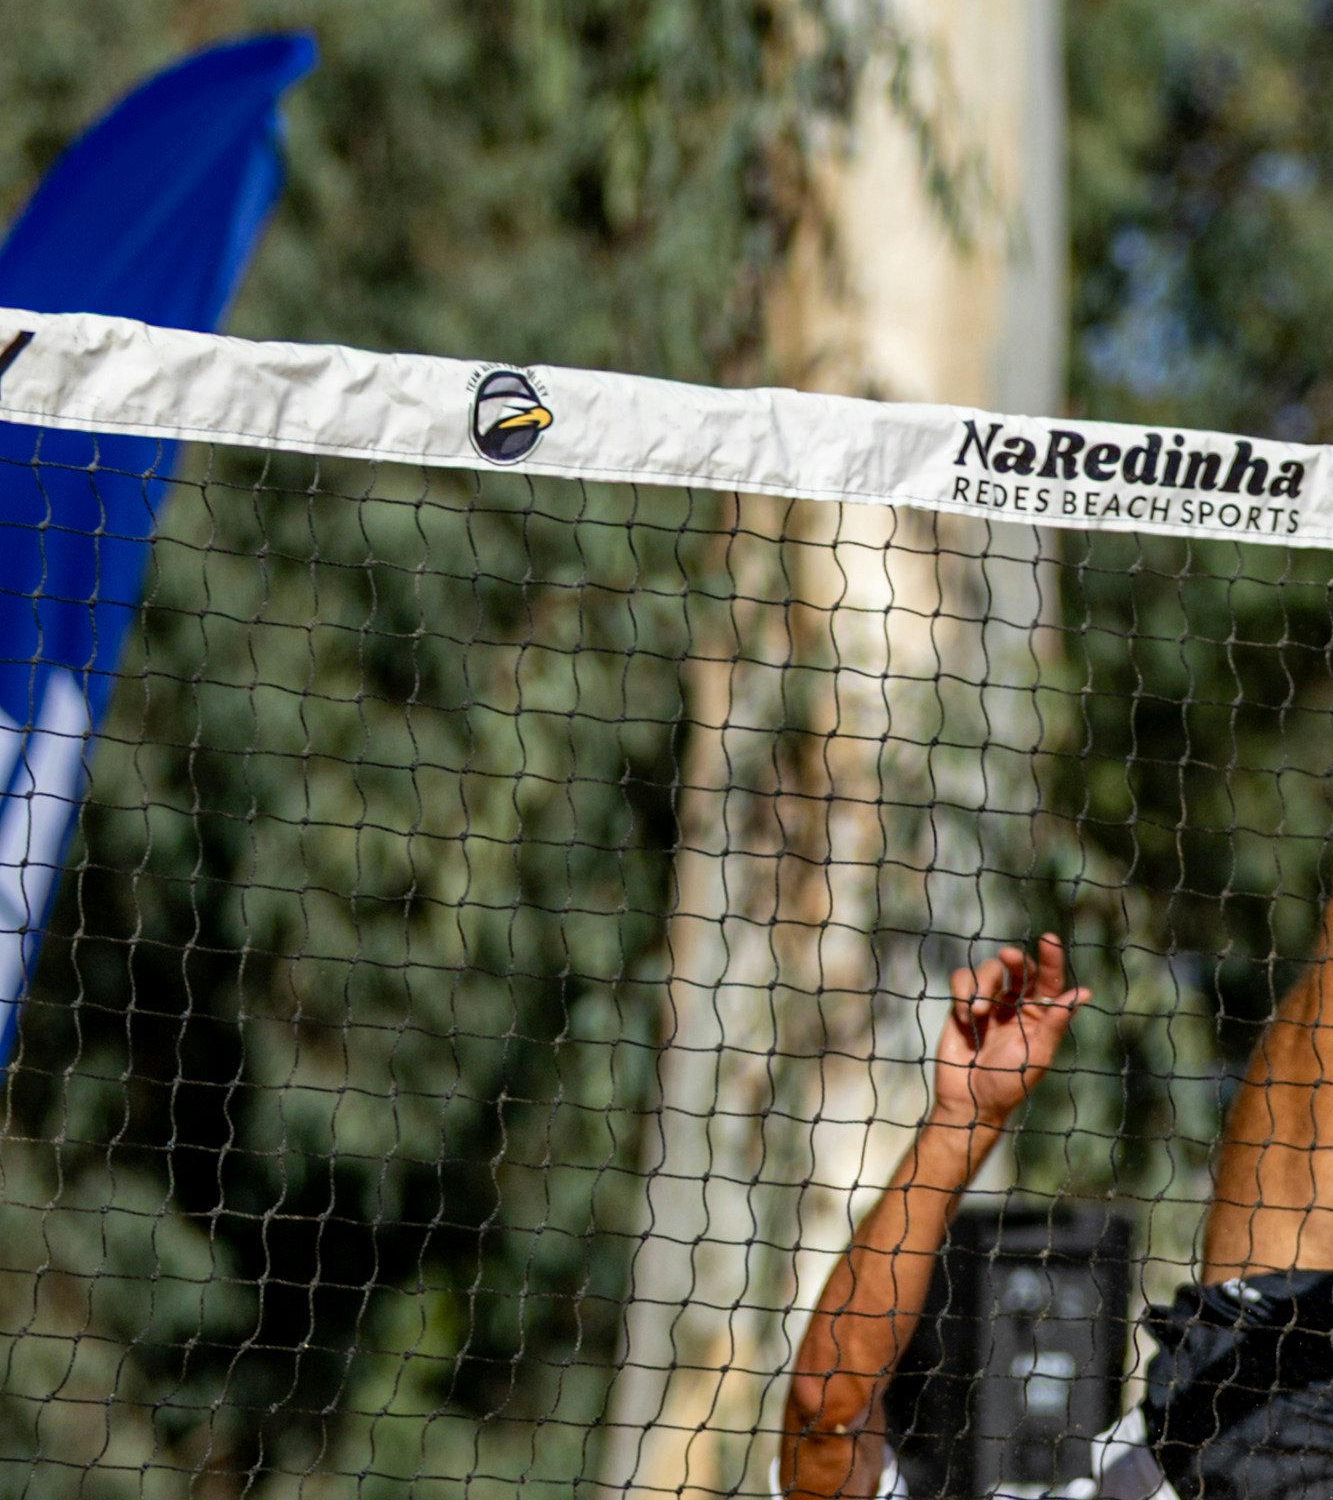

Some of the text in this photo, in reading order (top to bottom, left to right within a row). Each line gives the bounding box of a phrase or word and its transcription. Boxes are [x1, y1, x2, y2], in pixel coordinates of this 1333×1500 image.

[953, 419, 1305, 499] NaRedinha
[952, 476, 1299, 533] REDES BEACH SPORTS
